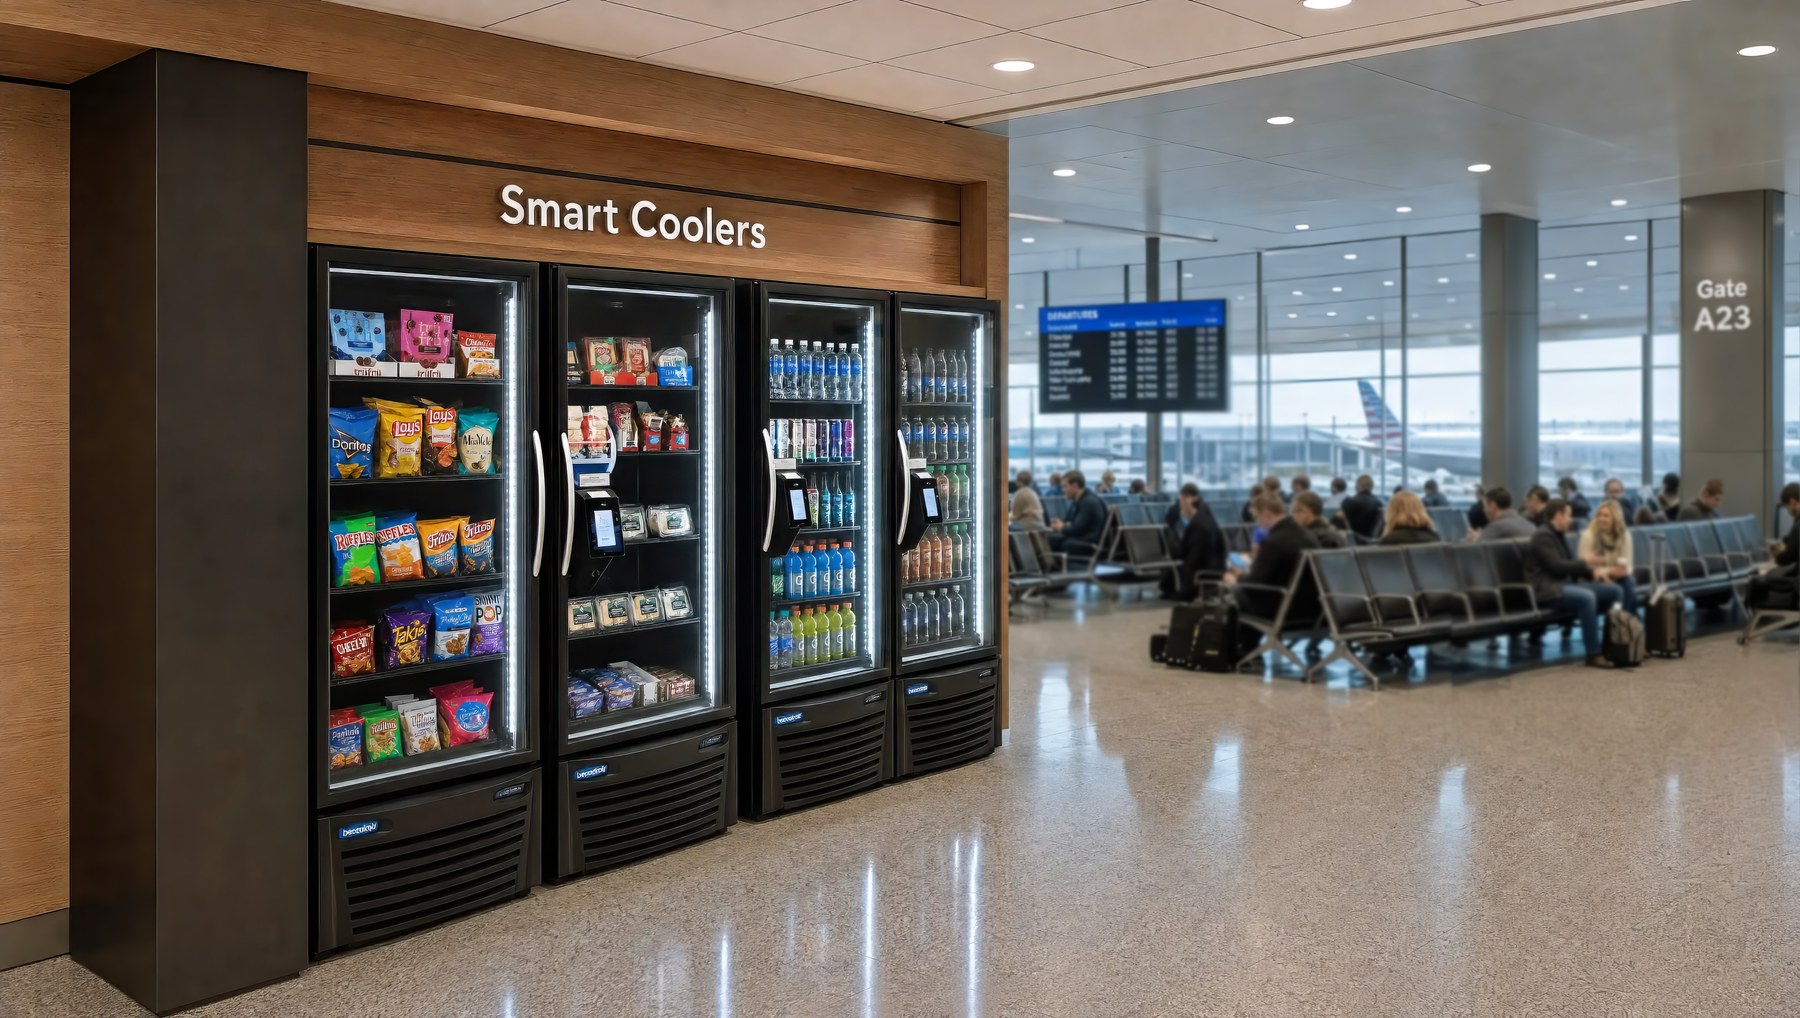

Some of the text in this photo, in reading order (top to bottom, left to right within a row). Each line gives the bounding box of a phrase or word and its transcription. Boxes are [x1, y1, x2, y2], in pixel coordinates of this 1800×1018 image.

[500, 184, 766, 249] Smart Coolers
[1696, 279, 1748, 299] Gate
[1693, 304, 1752, 332] A23
[332, 438, 372, 453] Doritos
[476, 605, 502, 622] POP
[392, 619, 426, 647] Takis
